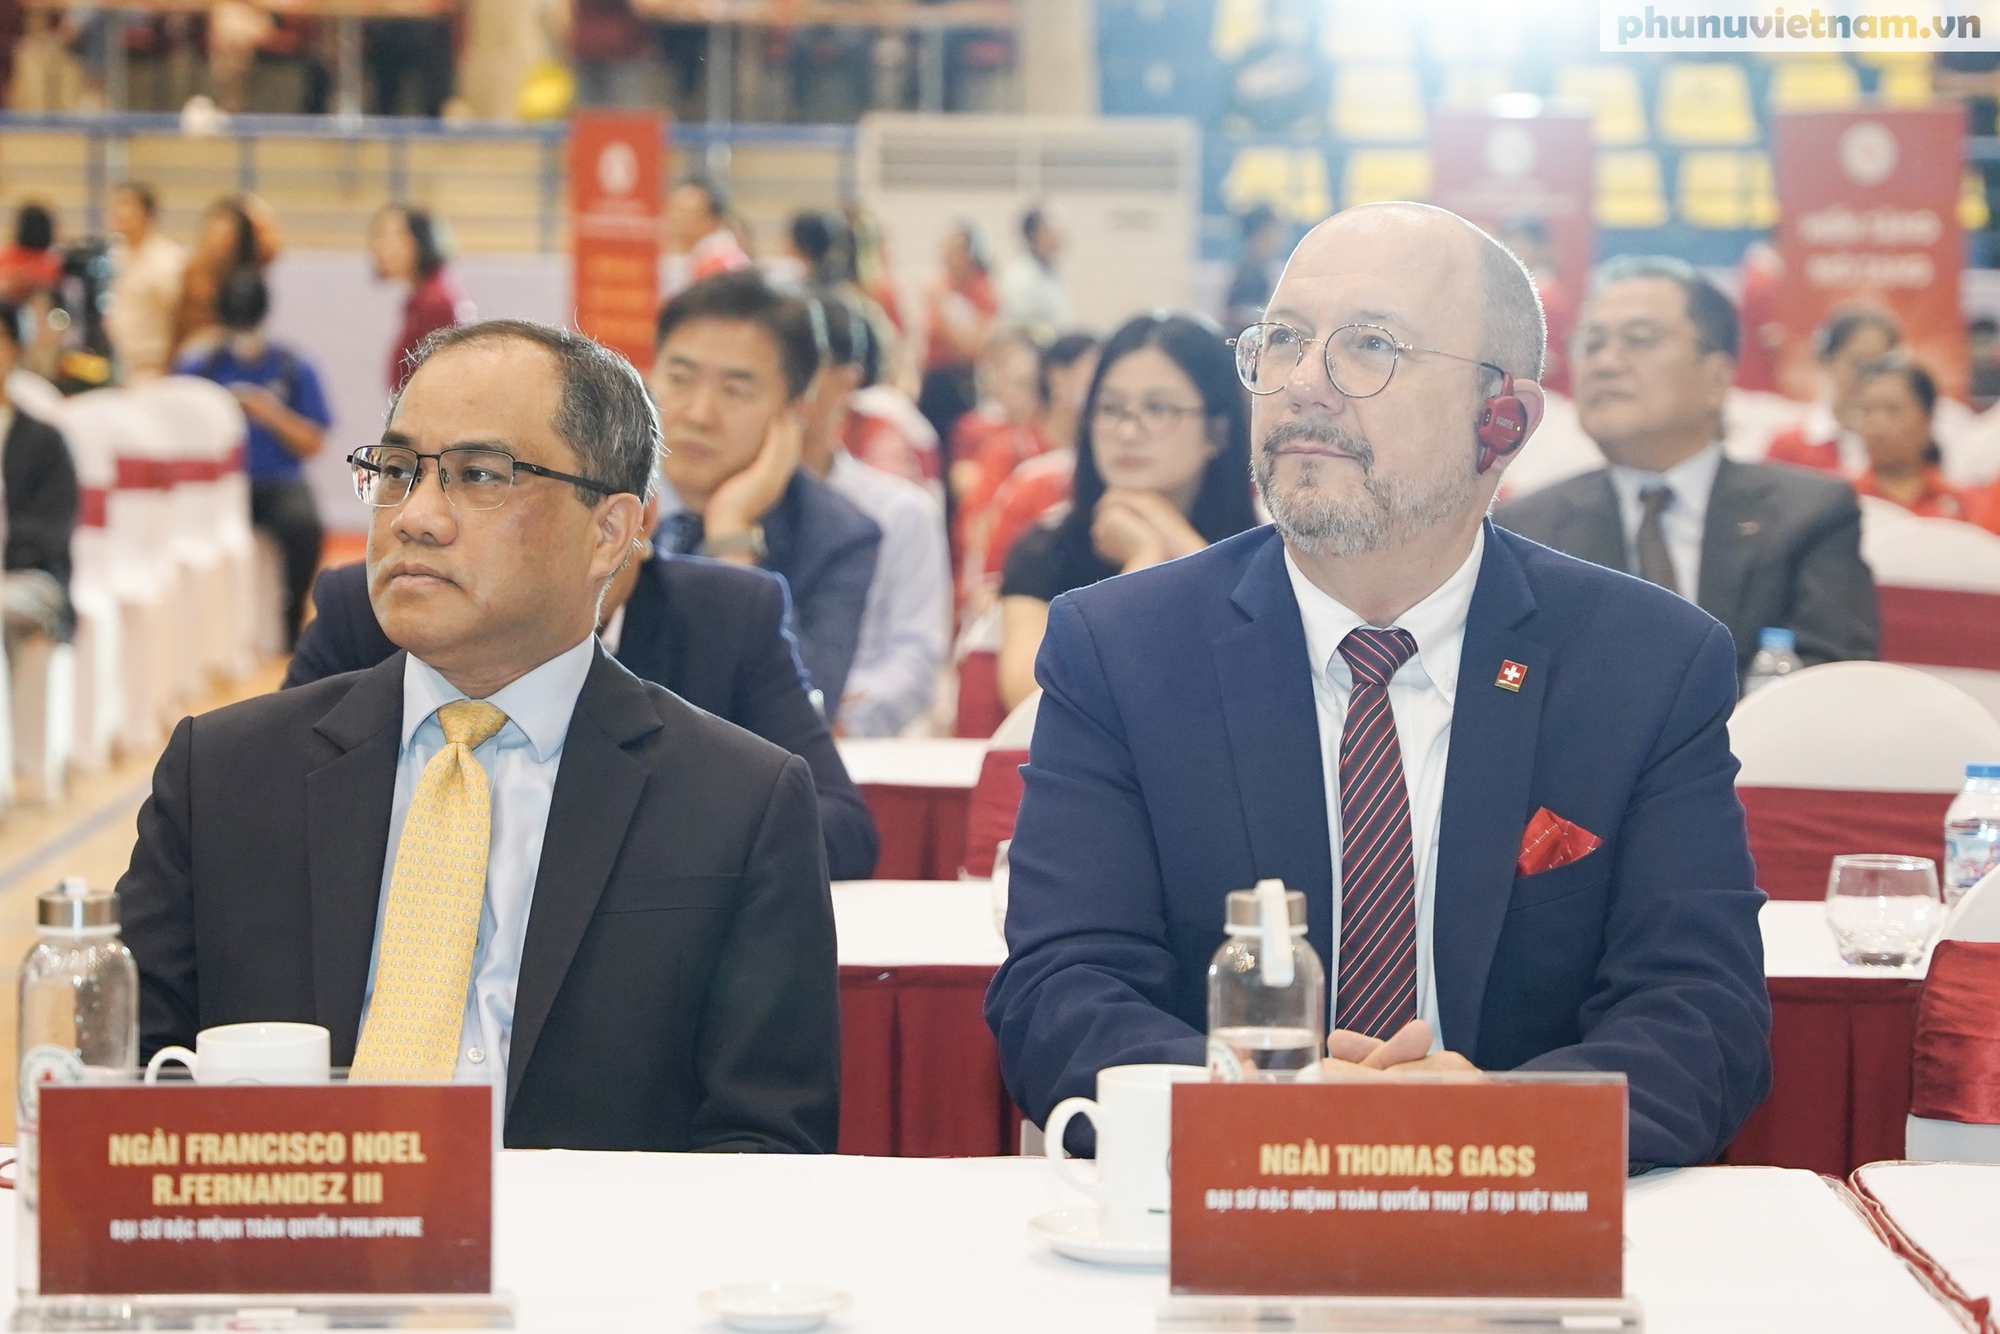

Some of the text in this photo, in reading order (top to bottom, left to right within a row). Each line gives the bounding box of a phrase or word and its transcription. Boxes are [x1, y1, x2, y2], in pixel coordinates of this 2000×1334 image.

[108, 1127, 427, 1165] NGÀI FRANCISCO NOEL
[1260, 1138, 1536, 1177] NGÀI THOMAS GASS
[152, 1172, 383, 1205] R.FERNANDEZ III
[1551, 1191, 1589, 1212] NAM
[339, 1216, 424, 1238] PHILIPPINE
